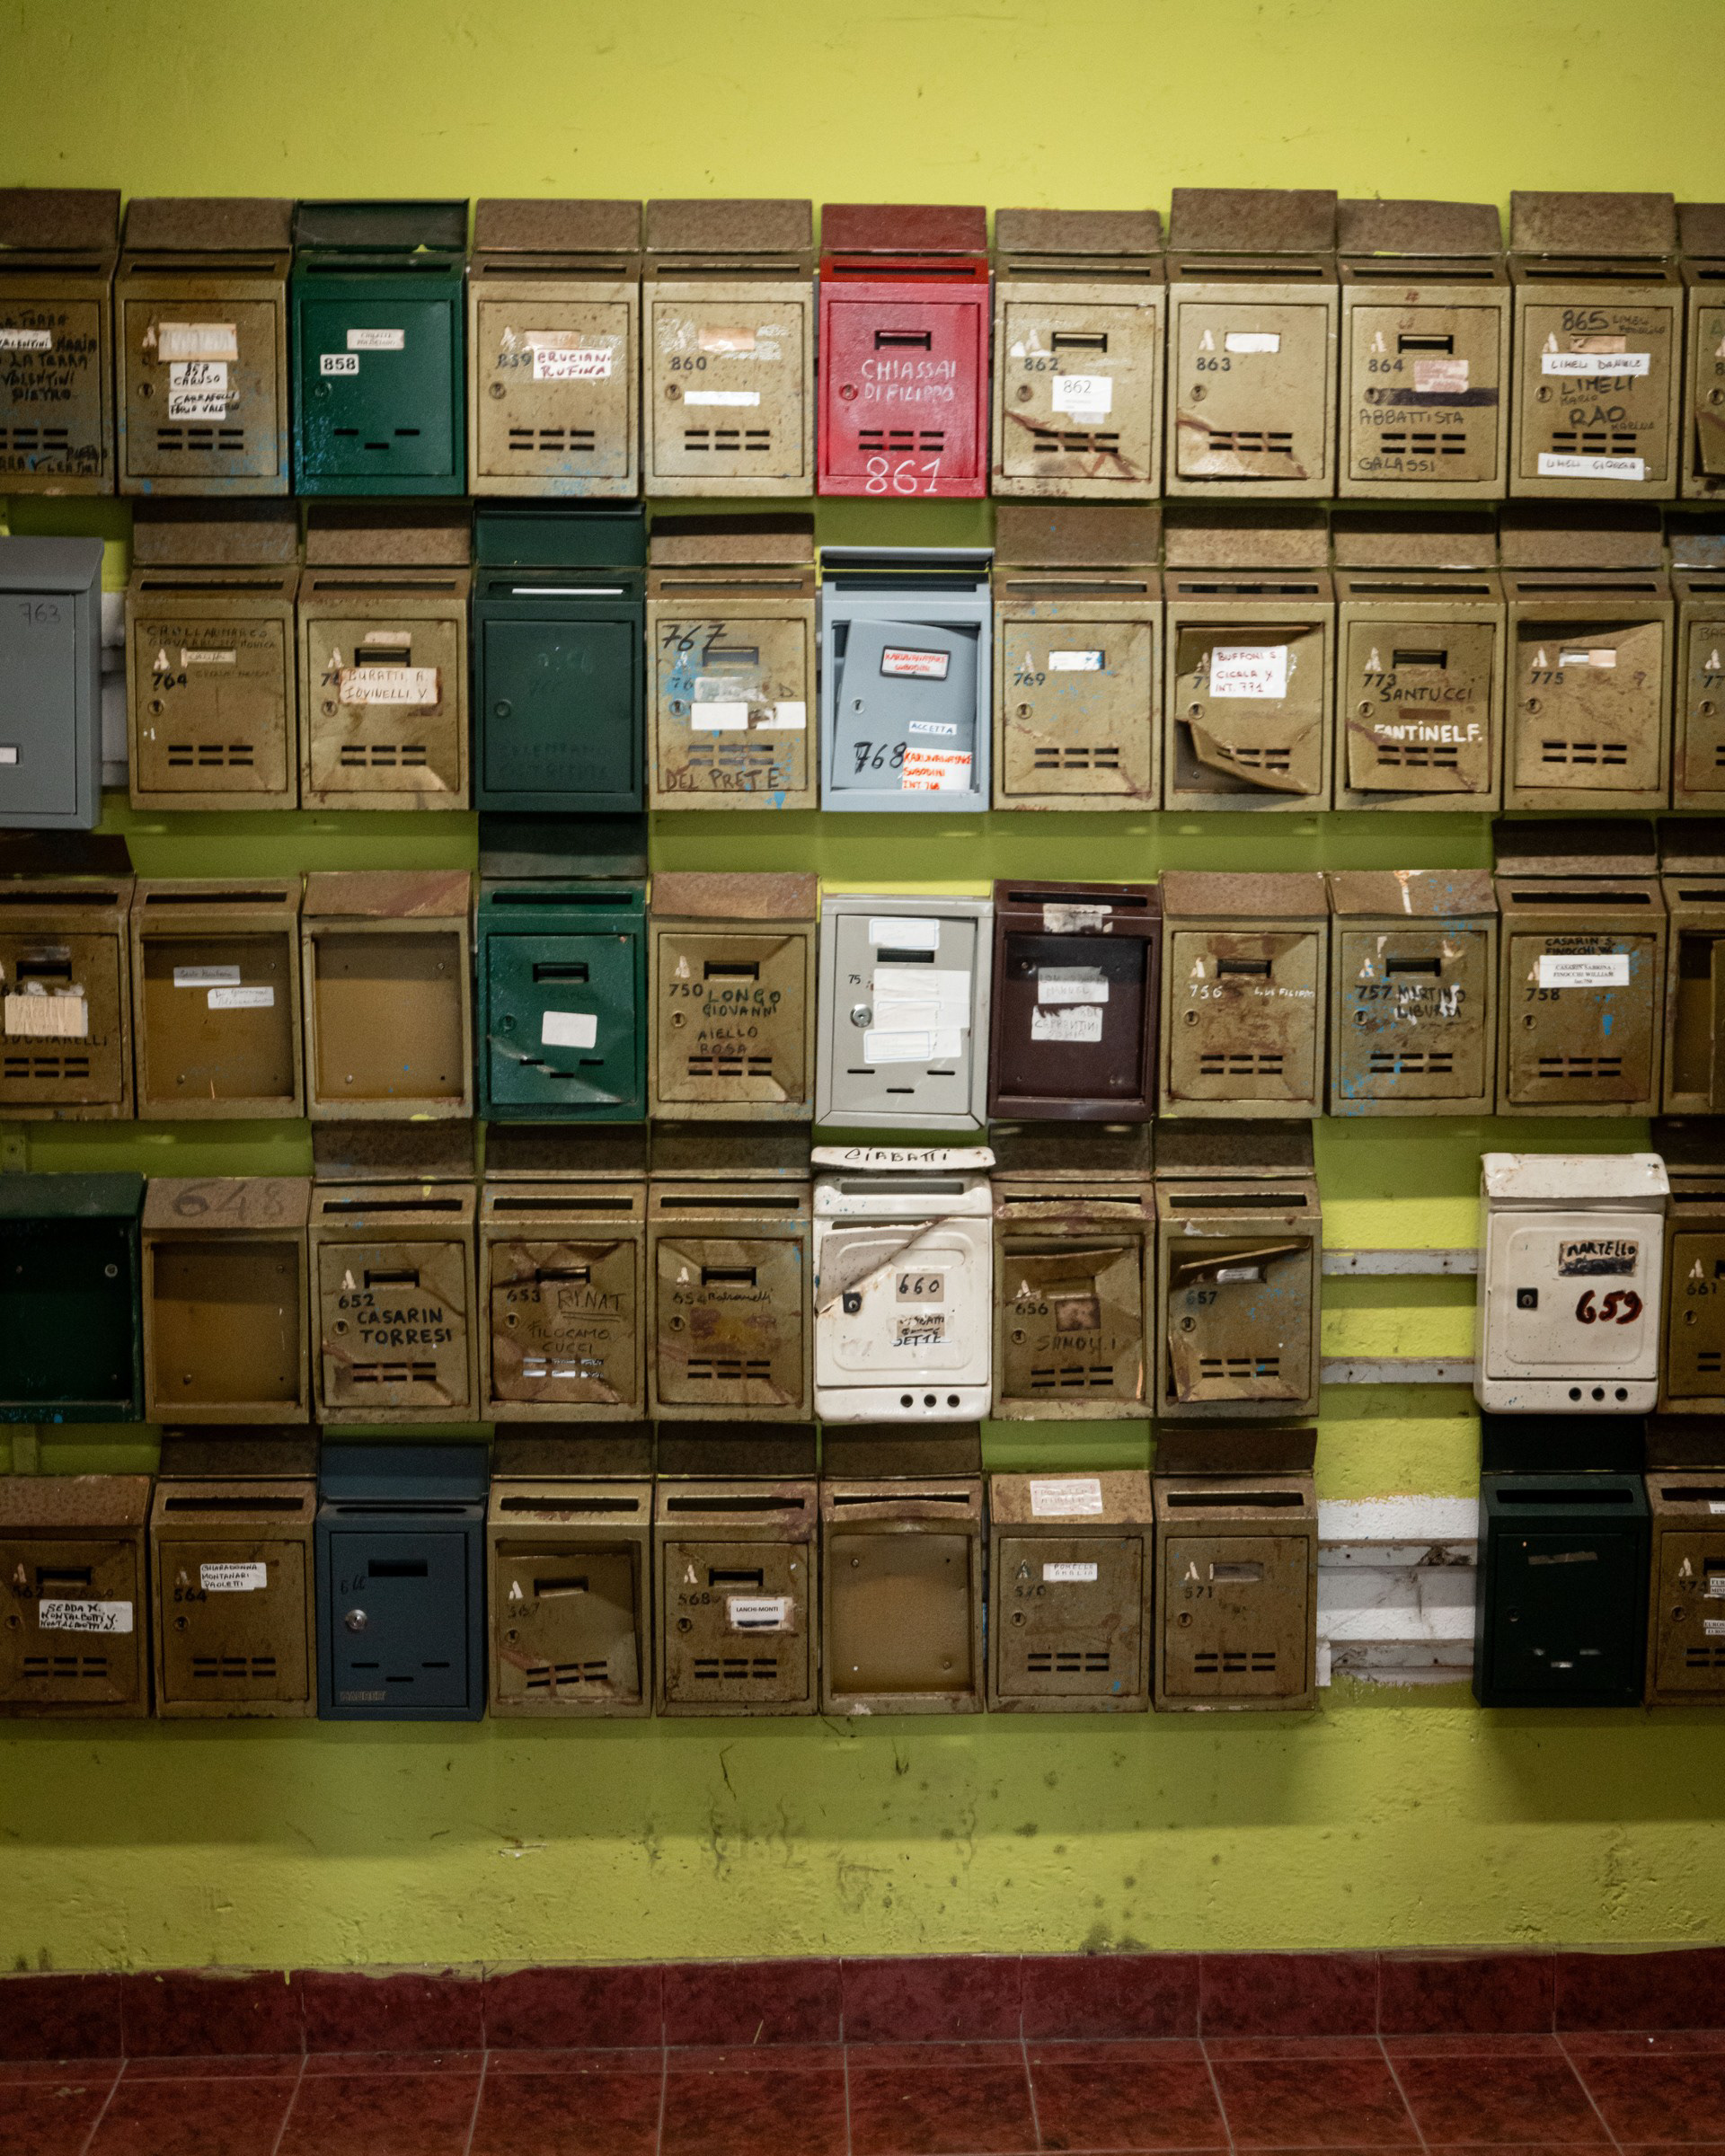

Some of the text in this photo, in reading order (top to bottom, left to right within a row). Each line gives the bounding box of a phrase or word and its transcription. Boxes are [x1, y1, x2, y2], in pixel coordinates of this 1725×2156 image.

[1563, 309, 1609, 331] 865
[324, 358, 356, 370] 858
[670, 356, 707, 371] 860
[861, 358, 957, 381] CHIASSAI
[1024, 358, 1058, 371] 862
[1196, 356, 1232, 372] 863
[1368, 358, 1403, 373] 864
[864, 383, 954, 403] DI FILIPPO
[1064, 380, 1092, 393] 862
[1561, 376, 1634, 395] LIMELI
[1359, 409, 1464, 426] ABBATTISTA
[1569, 405, 1626, 428] RAO
[1358, 457, 1437, 473] GALASSI
[864, 456, 942, 494] 861
[19, 603, 60, 625] 763
[661, 623, 728, 651] 767
[1216, 651, 1264, 661] BUFFONI
[1013, 673, 1046, 686] 769
[1363, 674, 1397, 687] 773
[1531, 671, 1564, 685] 775
[1240, 683, 1263, 693] 771
[1380, 687, 1473, 703] SANTUCCI
[911, 721, 954, 734] ACCETTA
[854, 741, 907, 774] 768
[666, 767, 780, 792] DEL PRETE
[848, 974, 862, 985] 75
[668, 983, 703, 997] 750
[708, 987, 782, 1006] LONGO
[1190, 985, 1223, 999] 756
[1355, 984, 1393, 1002] 757
[1526, 987, 1560, 1002] 758
[703, 1003, 777, 1017] GIOVANNI
[698, 1026, 758, 1041] AIELLO
[700, 1043, 747, 1056] ROSA
[1567, 1241, 1636, 1257] MARTELLO
[898, 1274, 940, 1294] 660
[1686, 1283, 1718, 1294] 661
[339, 1293, 375, 1309] 652
[1186, 1290, 1218, 1304] 657
[1015, 1303, 1048, 1315] 656
[1576, 1289, 1643, 1324] 659
[357, 1307, 443, 1324] CASARIN
[360, 1328, 452, 1347] TORRESI
[204, 1580, 243, 1588] PAOLETTI
[678, 1592, 711, 1605] 568
[1184, 1586, 1213, 1599] 571
